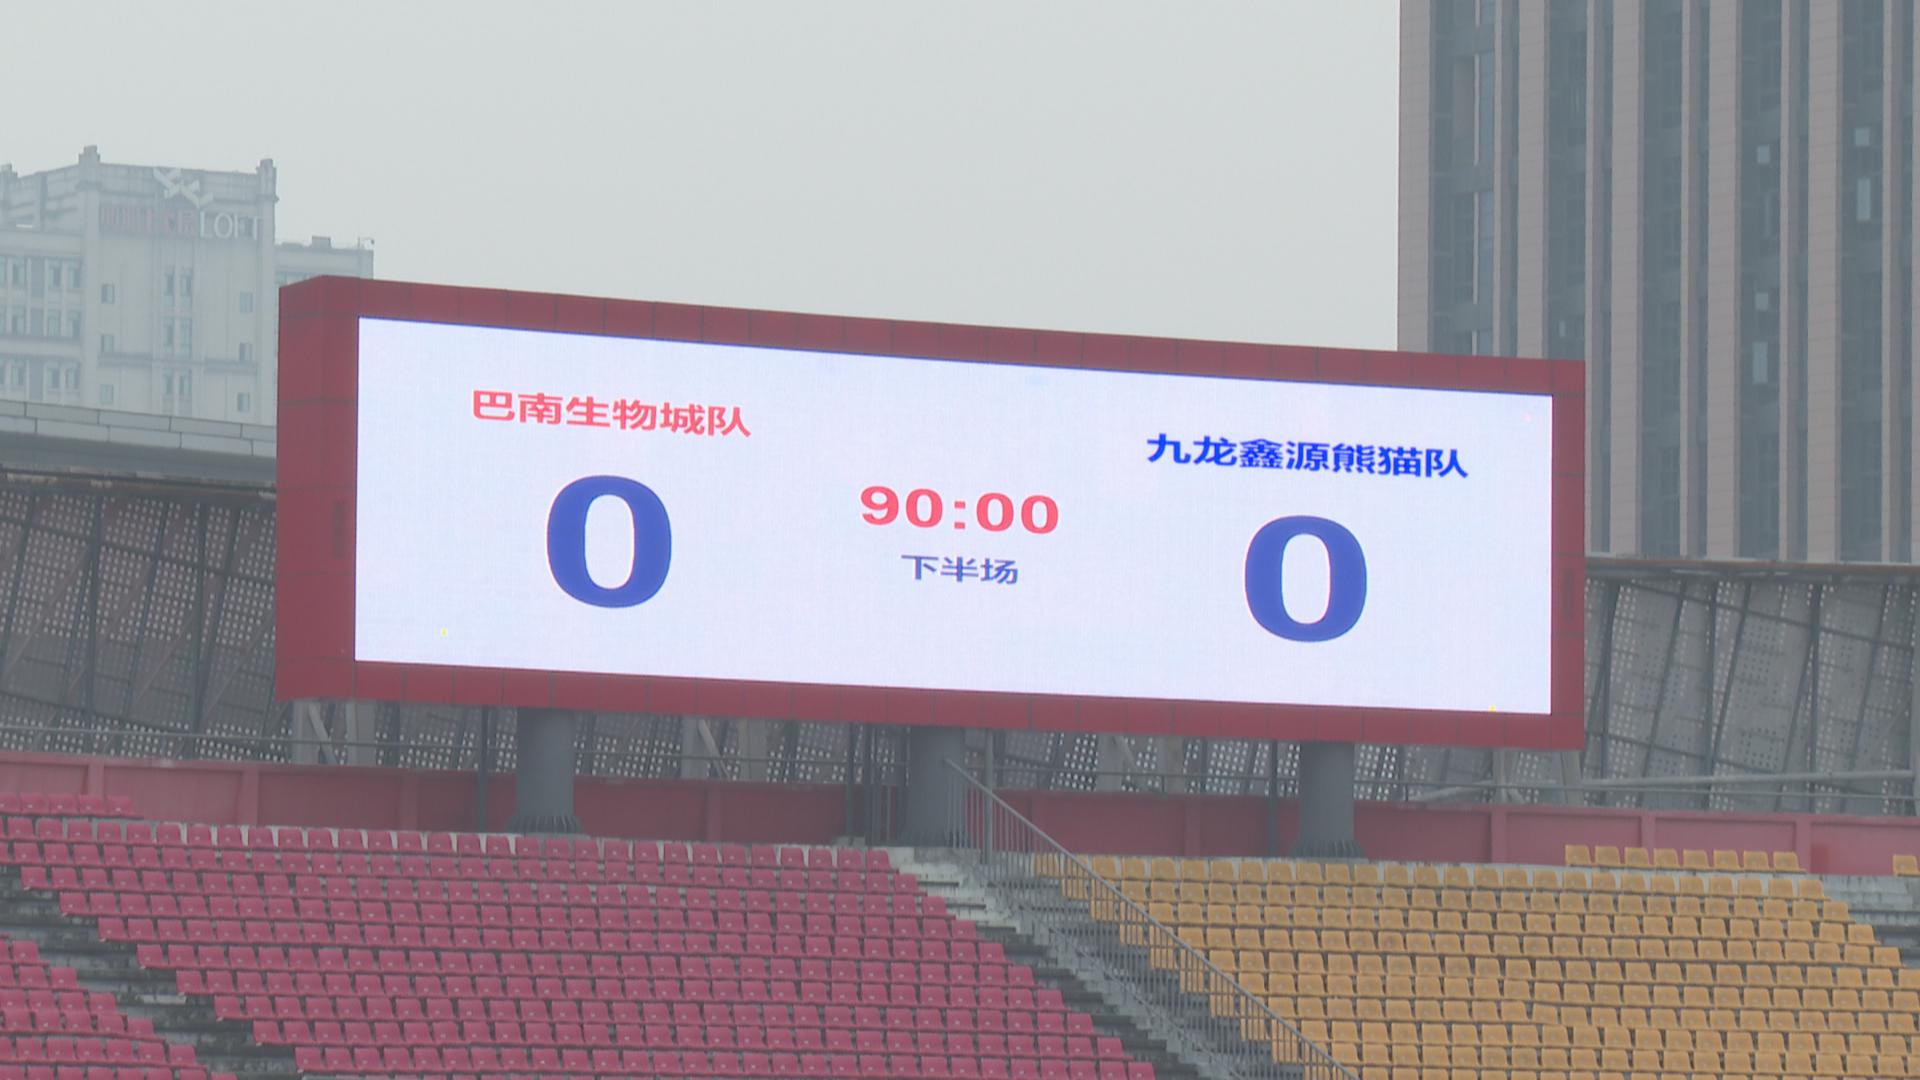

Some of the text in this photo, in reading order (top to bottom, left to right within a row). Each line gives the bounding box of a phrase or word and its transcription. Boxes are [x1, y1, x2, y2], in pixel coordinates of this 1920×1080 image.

[473, 389, 752, 438] 巴南生物城队
[1146, 433, 1469, 478] 九龙鑫源熊猫队
[860, 486, 1059, 534] 90:00
[547, 475, 672, 608] 0
[902, 555, 1018, 585] 下半场
[1245, 515, 1367, 642] 0
